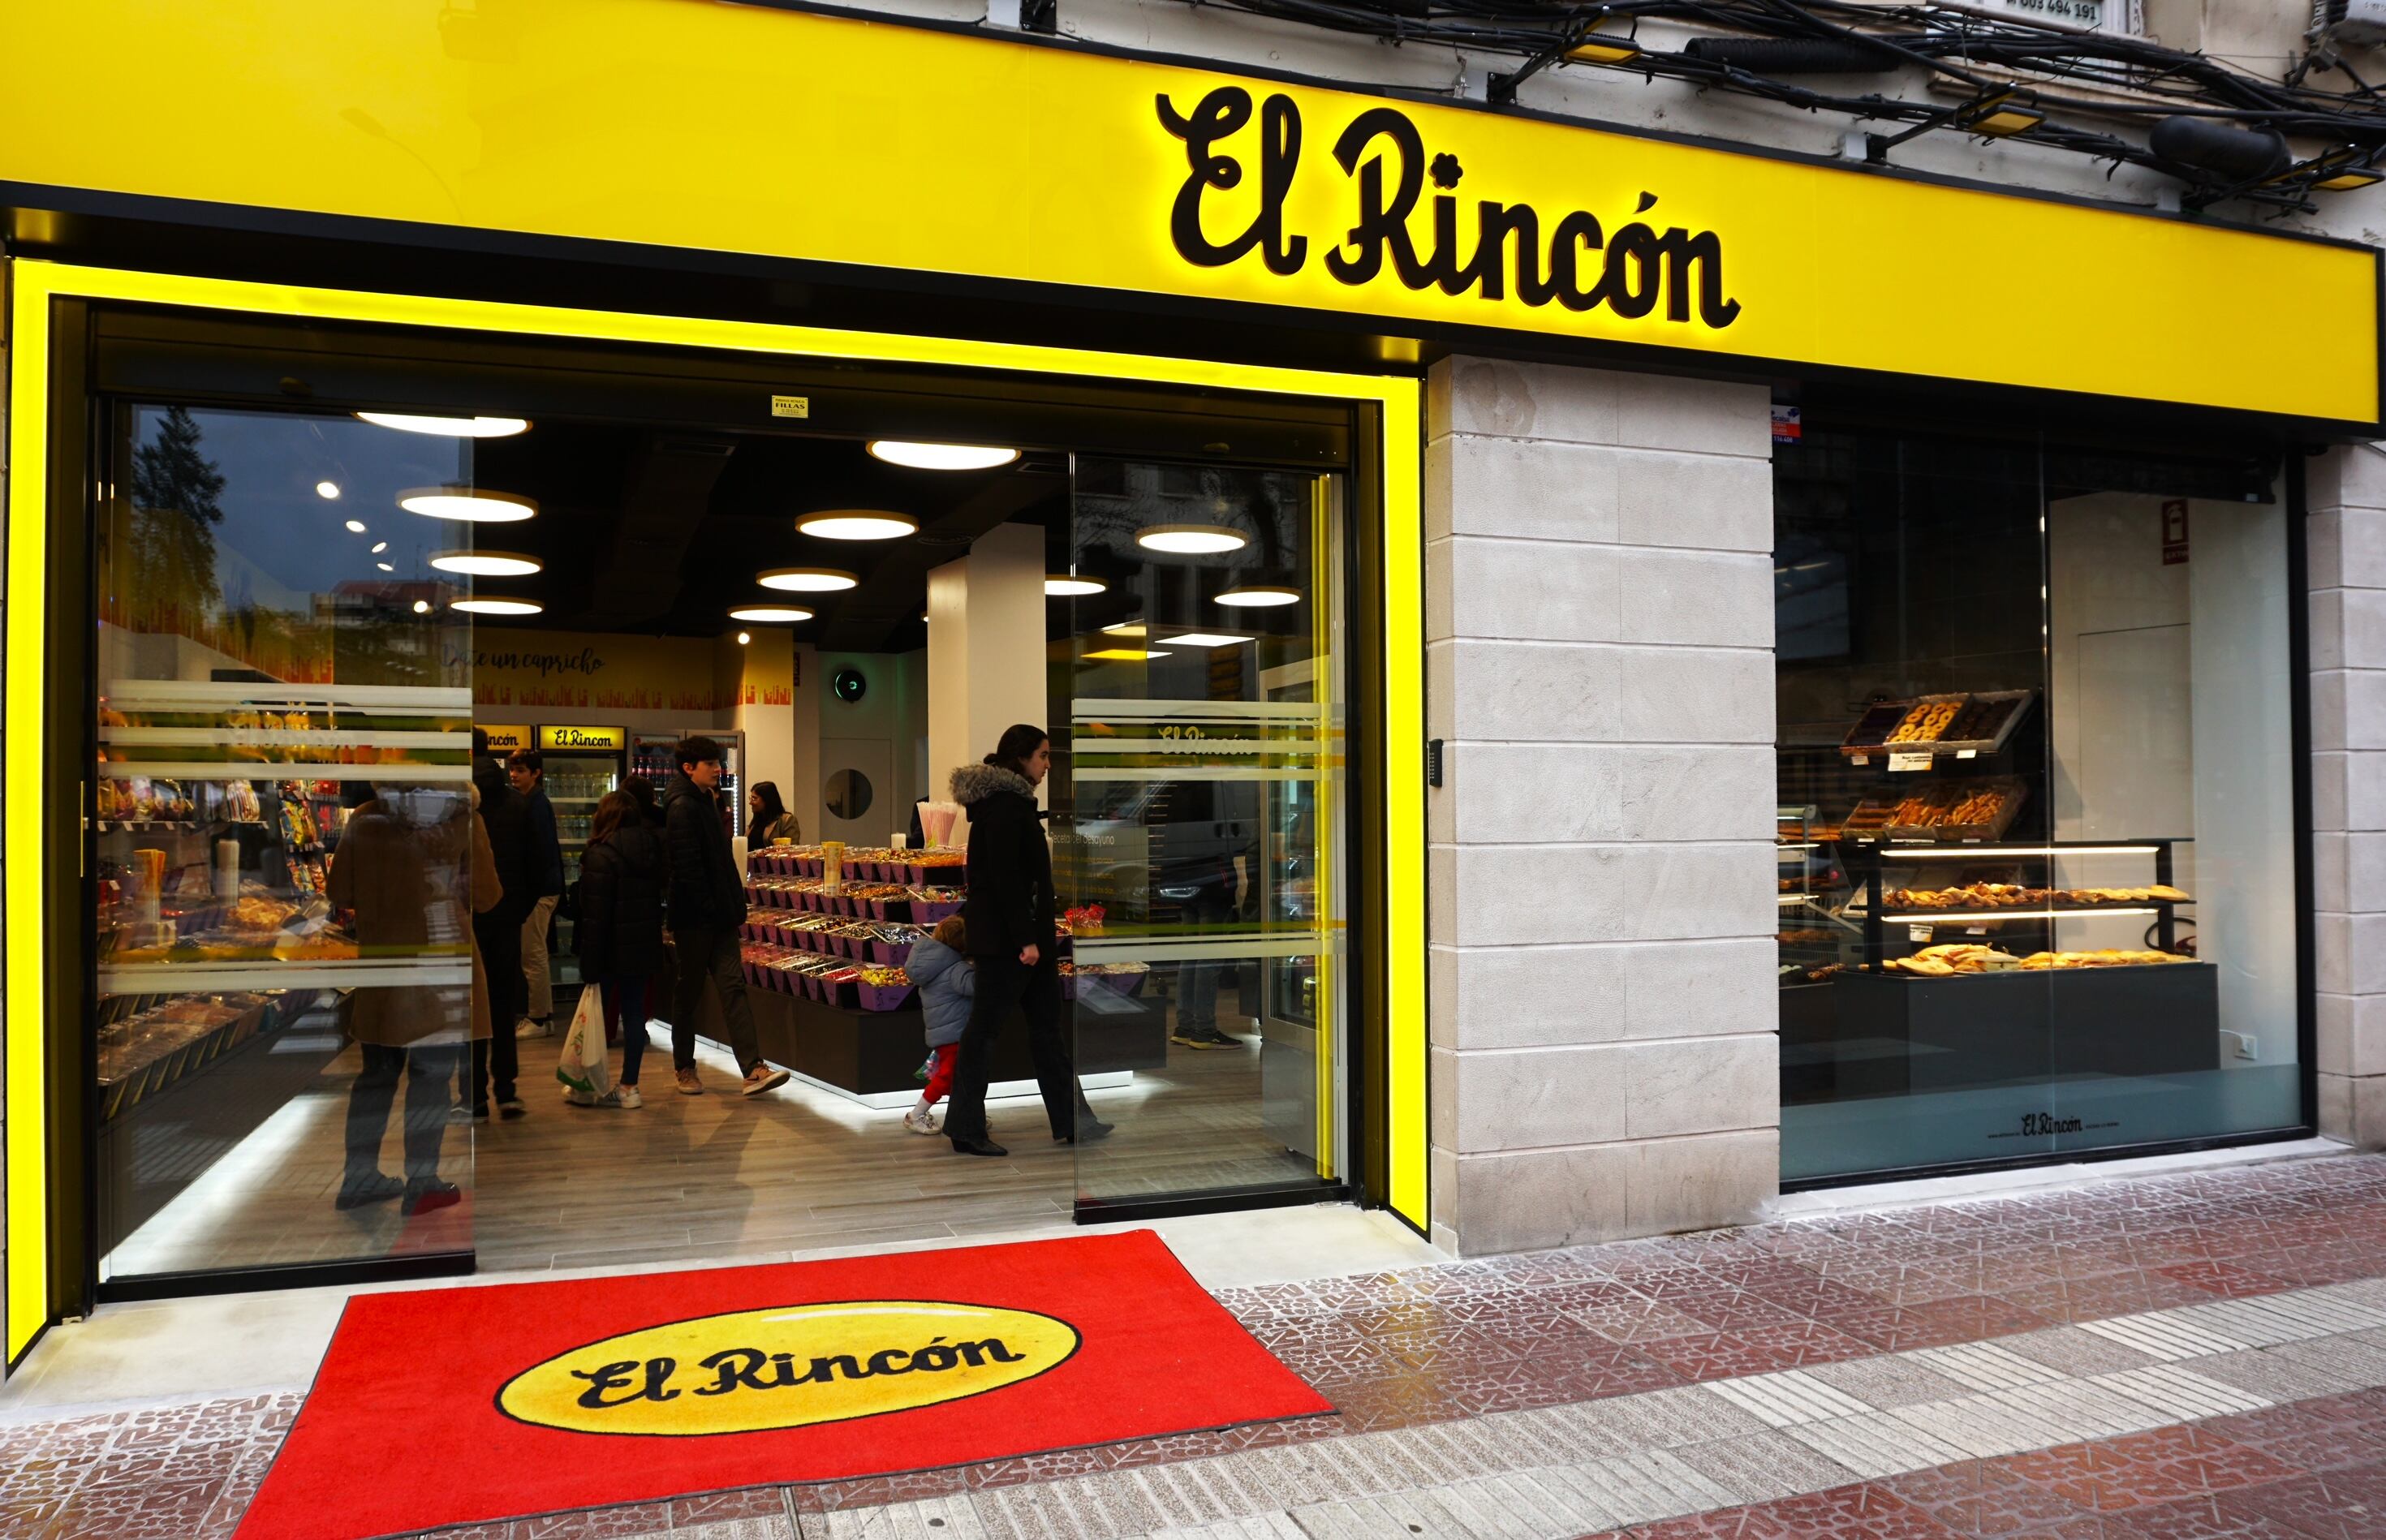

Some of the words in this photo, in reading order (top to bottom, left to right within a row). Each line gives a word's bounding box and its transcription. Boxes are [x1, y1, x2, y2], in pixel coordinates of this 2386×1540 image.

[2048, 0, 2071, 15] 494
[2075, 3, 2097, 19] 191
[1156, 86, 1307, 276] El
[1324, 108, 1741, 329] Rincón
[491, 652, 519, 669] un
[523, 647, 605, 677] capricho
[487, 733, 519, 746] ncón
[554, 729, 567, 746] El
[1083, 832, 1115, 847] desayuno
[2022, 1114, 2037, 1136] El
[571, 1357, 683, 1409] El
[692, 1336, 1026, 1397] Rincón
